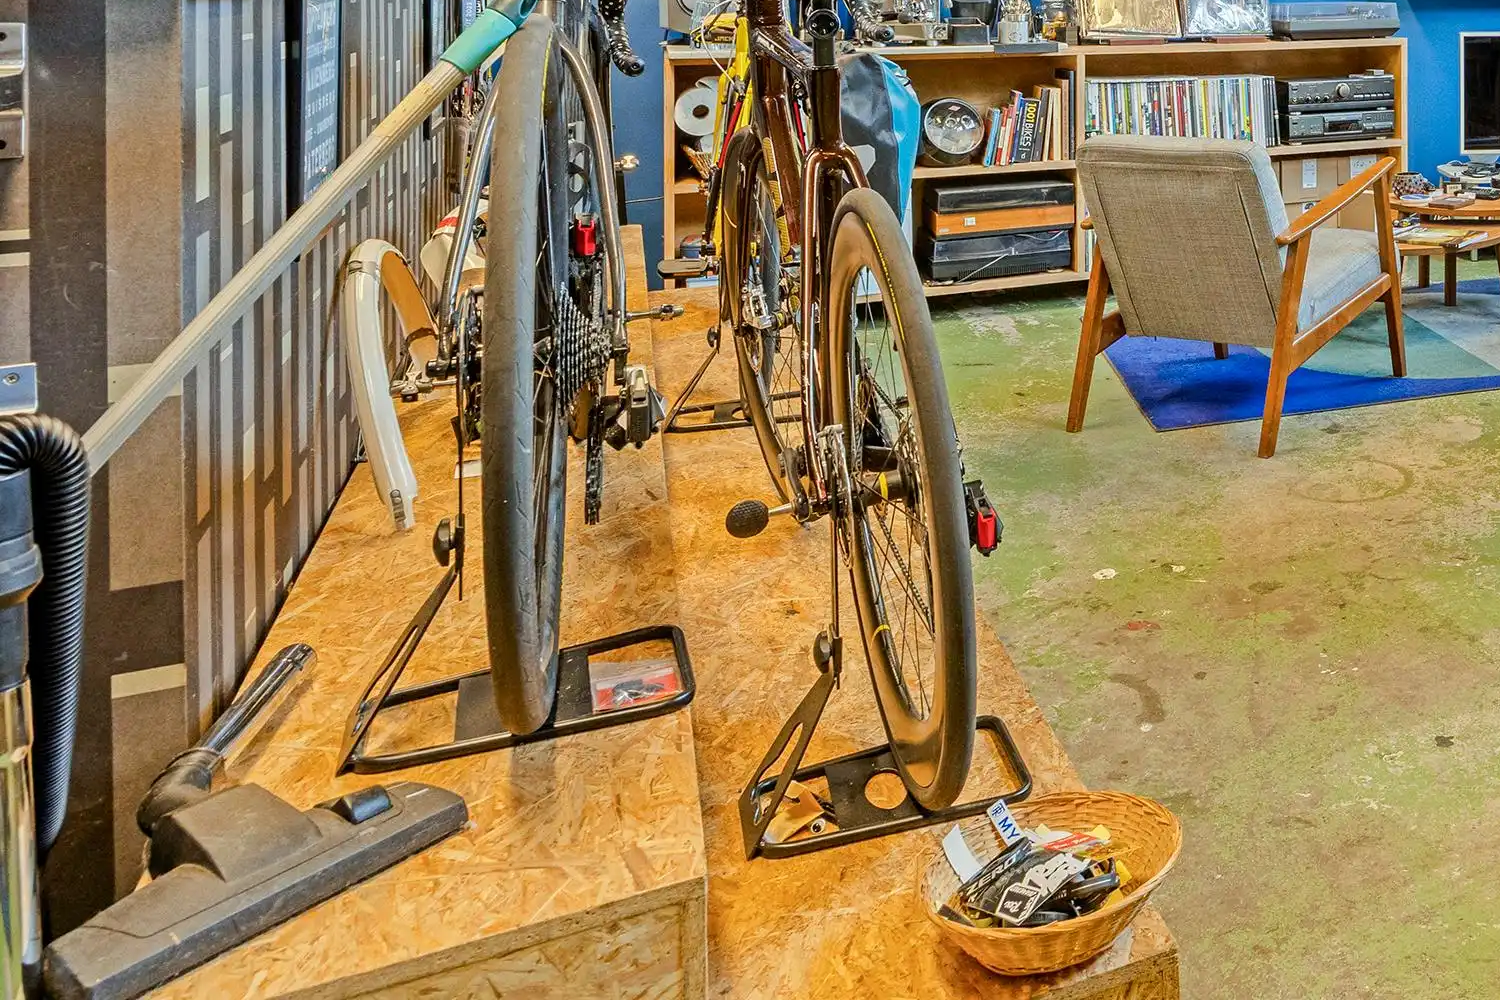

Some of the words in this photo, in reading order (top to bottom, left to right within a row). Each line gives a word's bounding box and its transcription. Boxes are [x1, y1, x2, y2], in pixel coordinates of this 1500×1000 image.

[1026, 103, 1037, 123] 1001
[1022, 122, 1034, 147] BIKES
[998, 816, 1021, 840] MY
